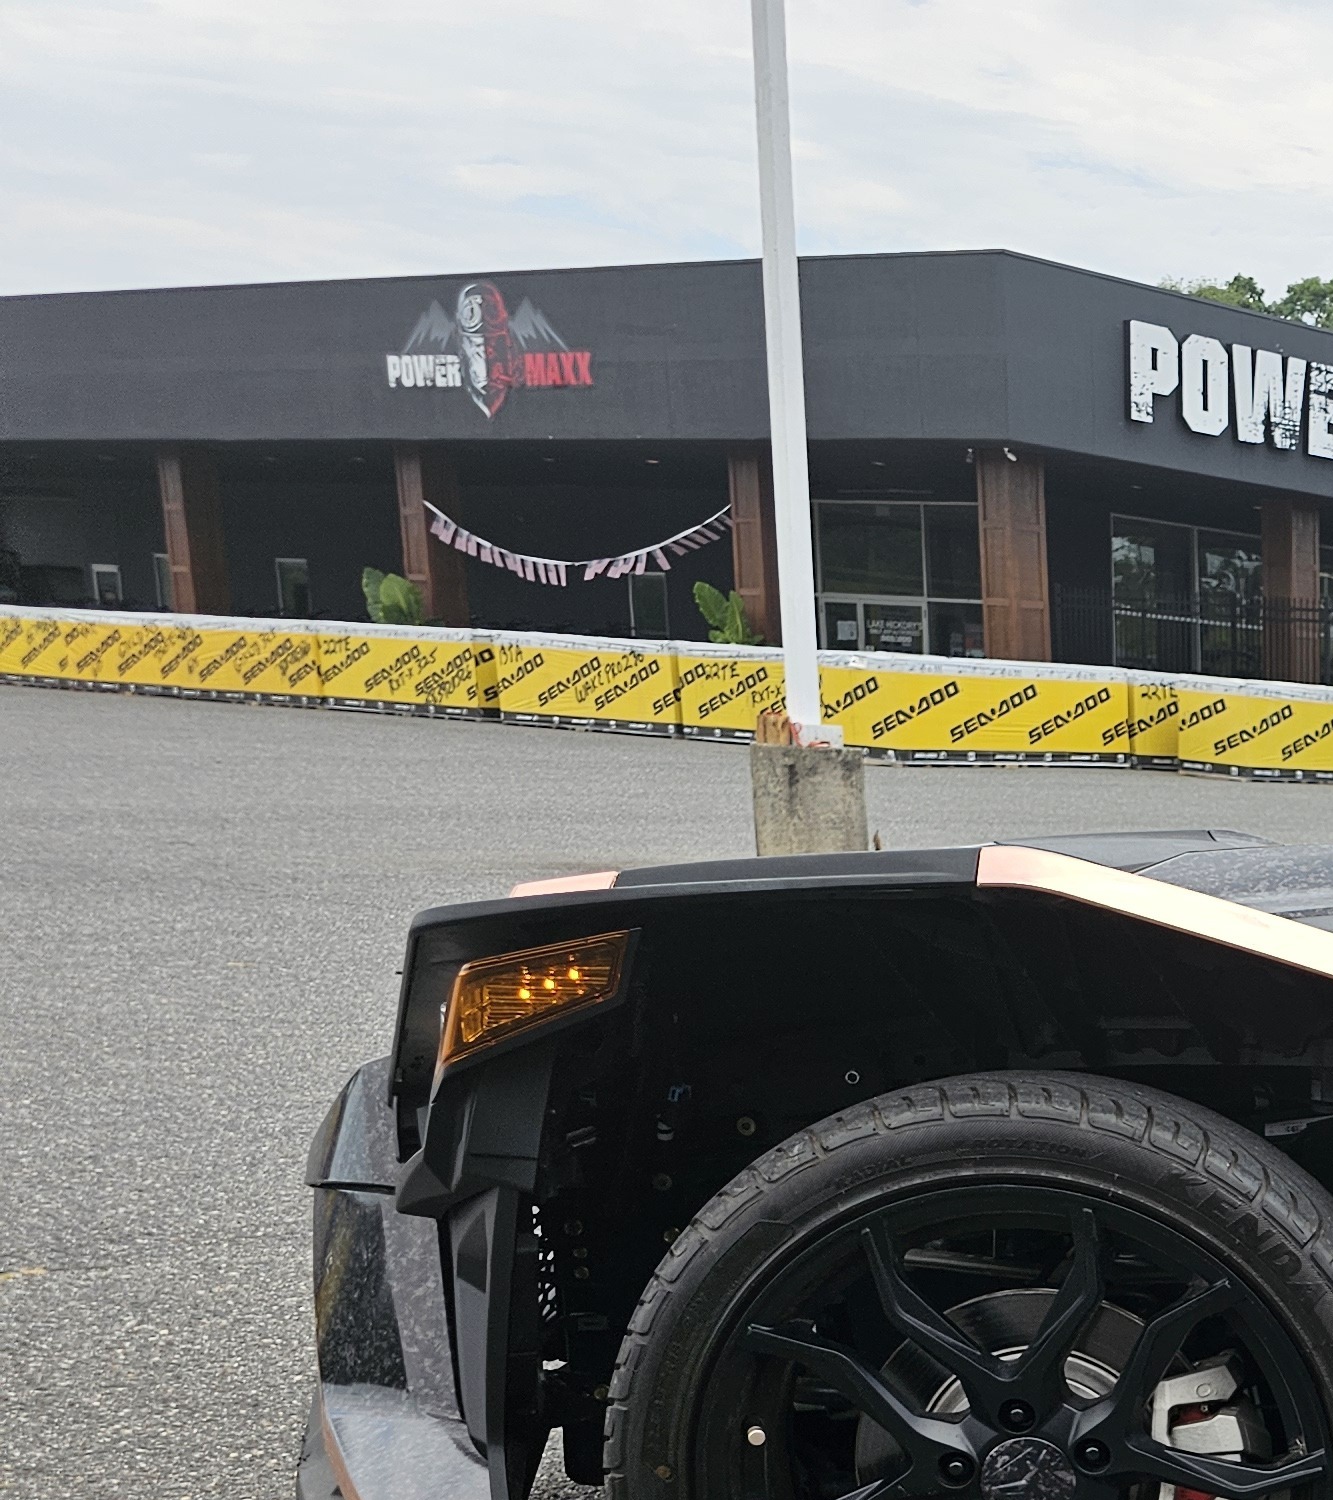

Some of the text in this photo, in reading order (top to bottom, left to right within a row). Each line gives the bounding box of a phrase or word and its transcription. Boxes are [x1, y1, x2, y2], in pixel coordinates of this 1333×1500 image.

[386, 352, 593, 388] POWER MAXX
[1155, 1168, 1329, 1306] KENDA
